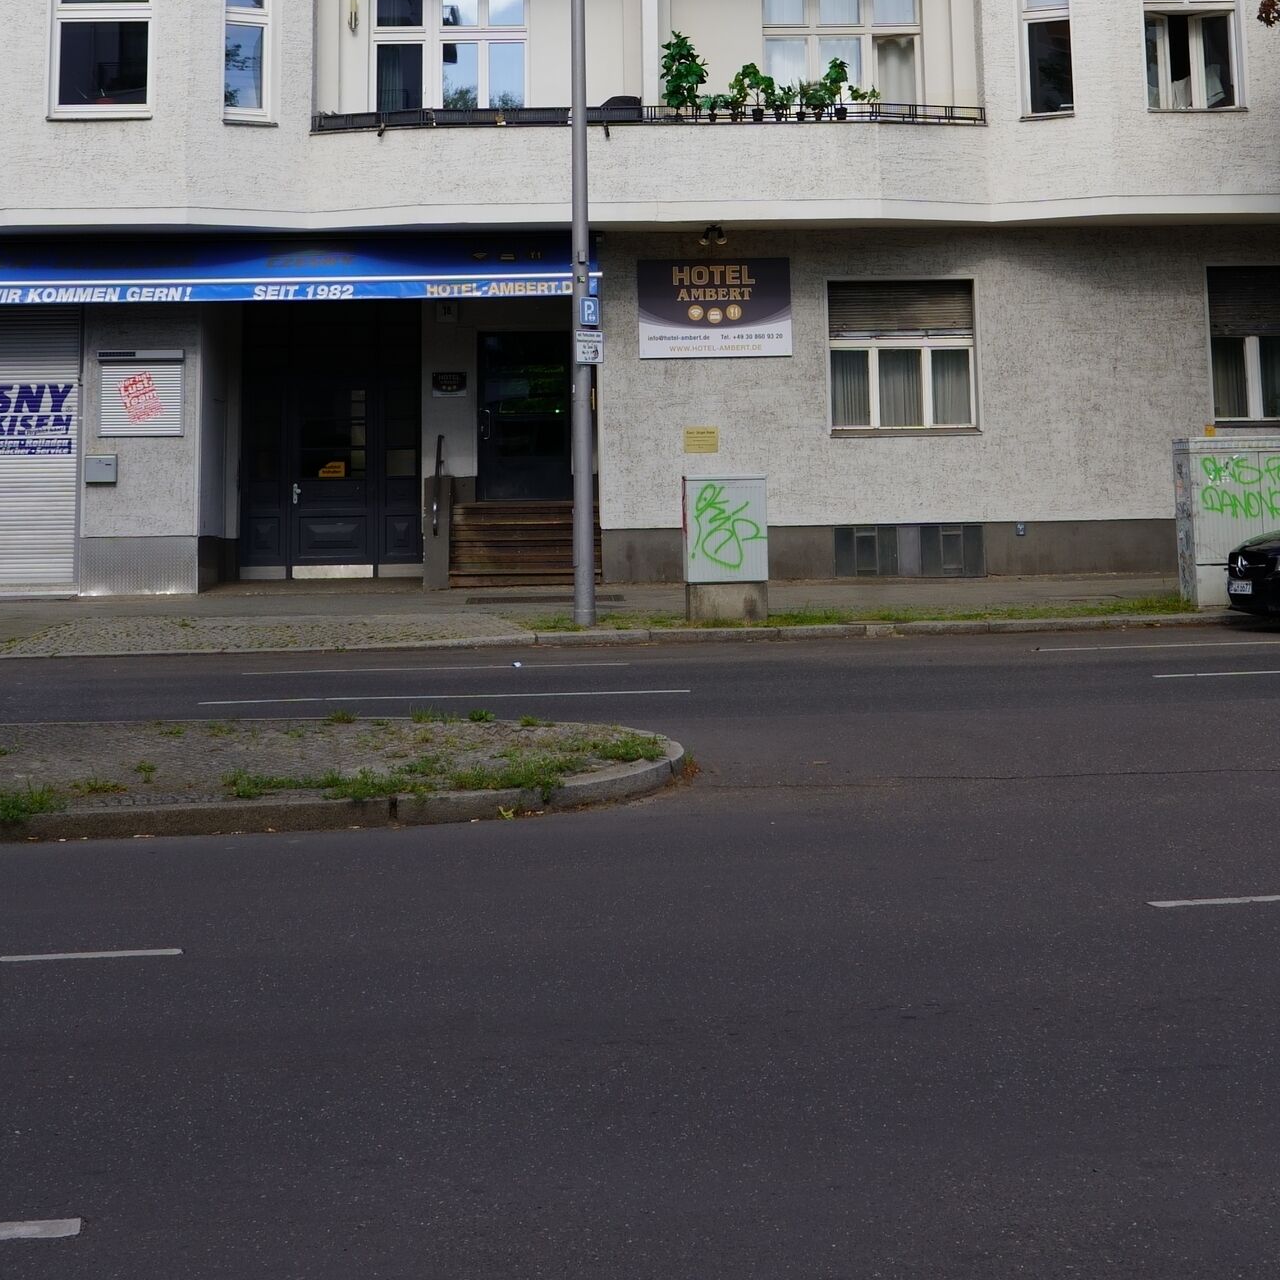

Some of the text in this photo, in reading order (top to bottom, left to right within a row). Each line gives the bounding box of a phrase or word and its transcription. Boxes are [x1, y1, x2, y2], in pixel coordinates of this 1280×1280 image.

[673, 265, 756, 286] HOTEL
[27, 287, 120, 303] KOMMEN
[126, 286, 192, 302] GERN!
[253, 284, 354, 301] SEIT 1982
[426, 281, 573, 297] HOTEL-AMBERT.D
[676, 288, 753, 302] AMBERT
[584, 301, 595, 321] P
[669, 344, 763, 352] WWW.HOTEL-AMBERT.DE
